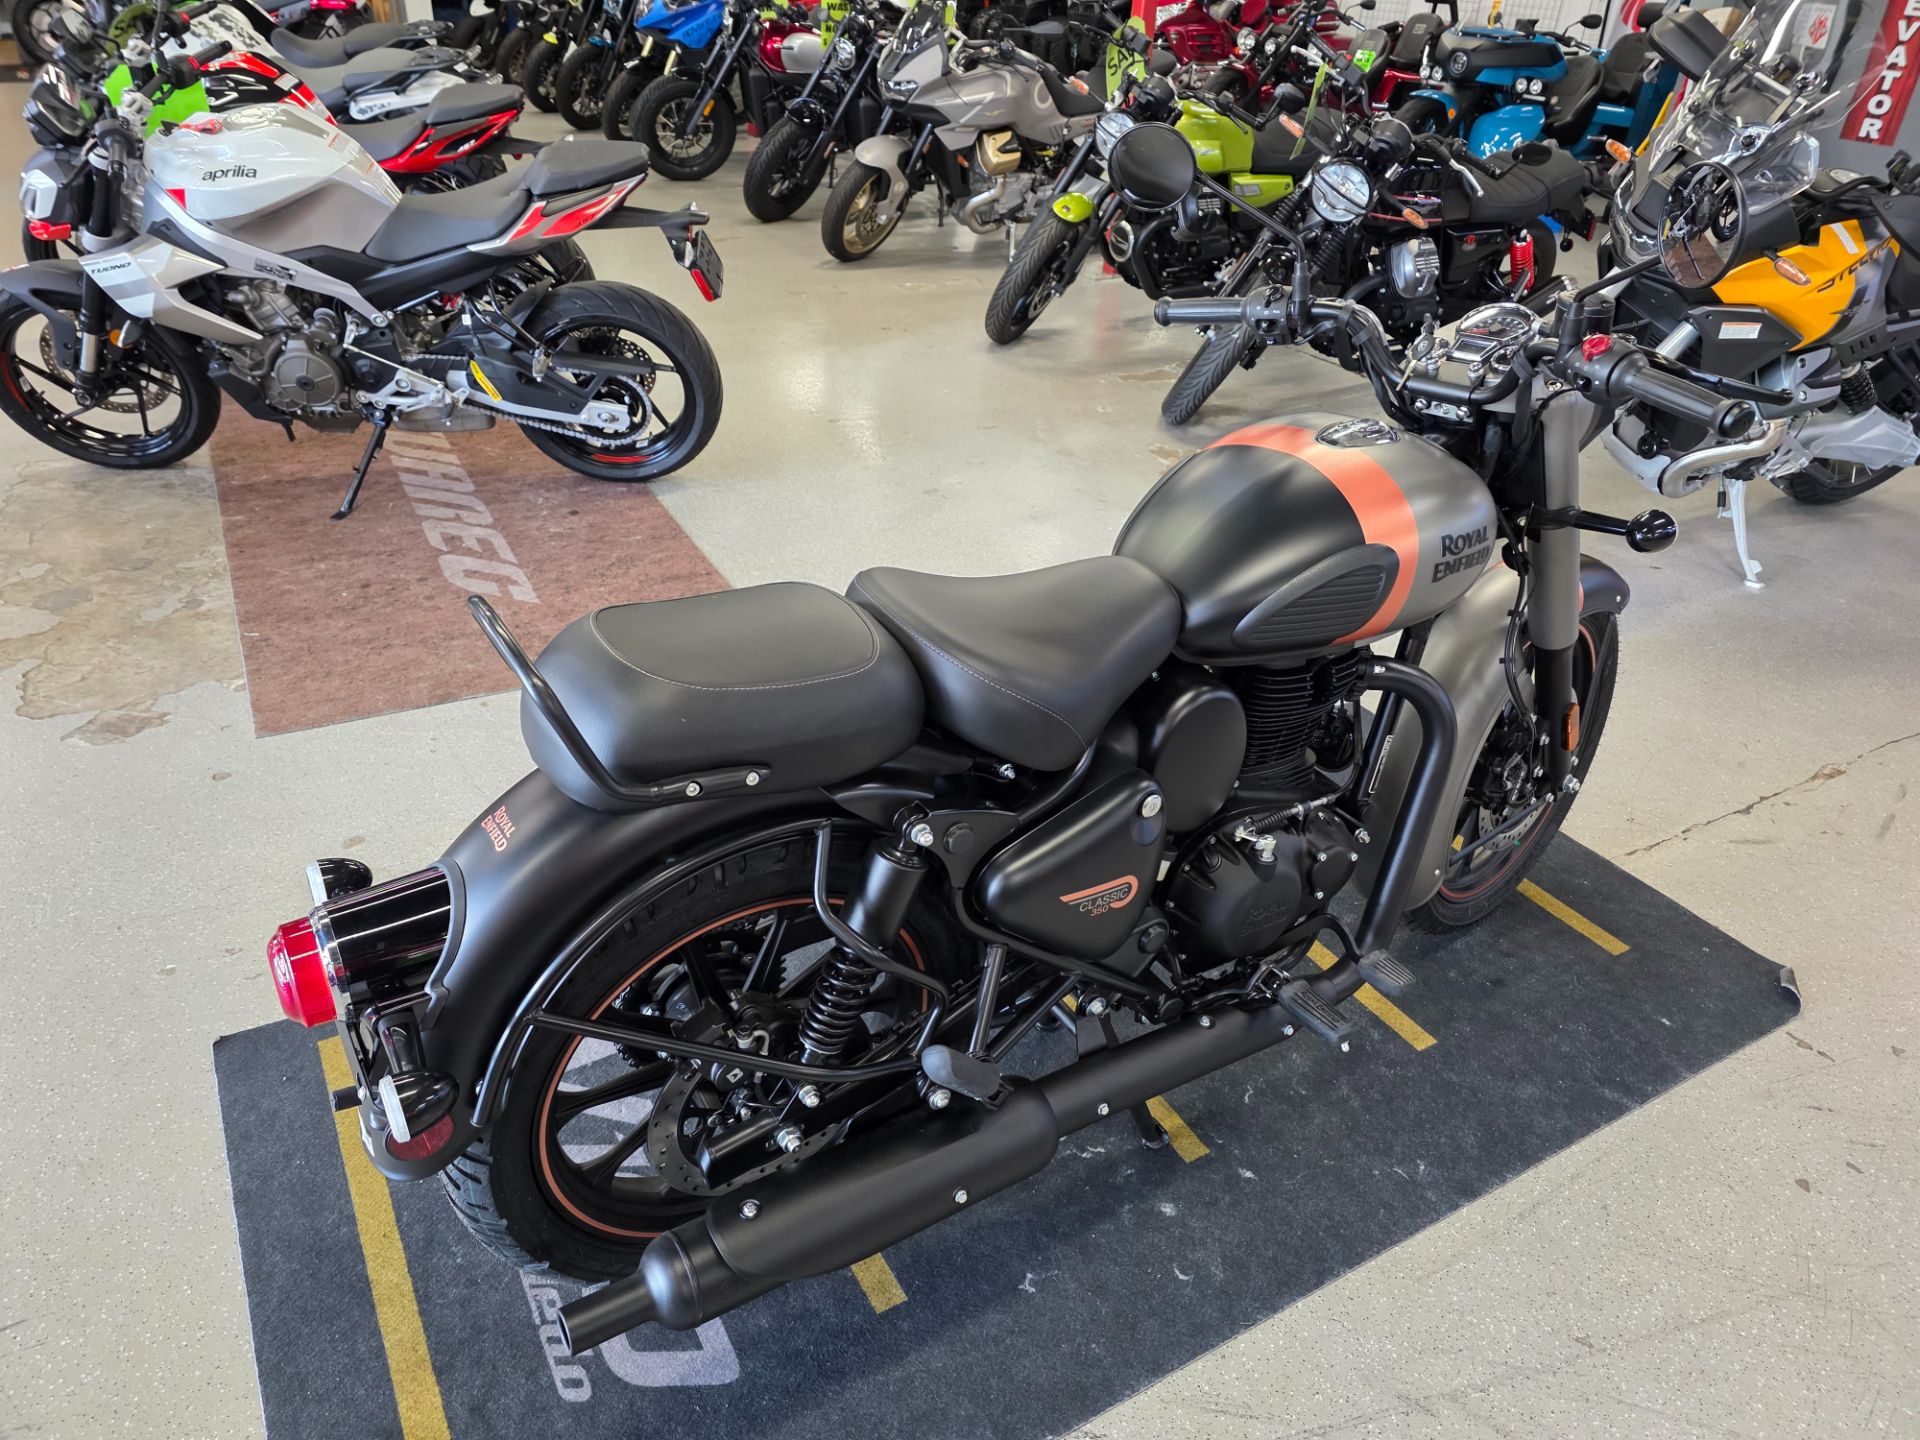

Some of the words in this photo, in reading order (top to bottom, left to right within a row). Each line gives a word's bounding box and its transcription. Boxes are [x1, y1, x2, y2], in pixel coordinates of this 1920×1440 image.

[202, 165, 257, 181] aprilia
[91, 262, 131, 274] TUONO
[1441, 526, 1489, 558] ROYAL
[1431, 545, 1490, 583] ENFIELD
[481, 815, 507, 852] ENFIELD
[493, 805, 515, 838] ROYAL
[1080, 888, 1128, 912] CLASSIC
[1090, 904, 1109, 916] 350
